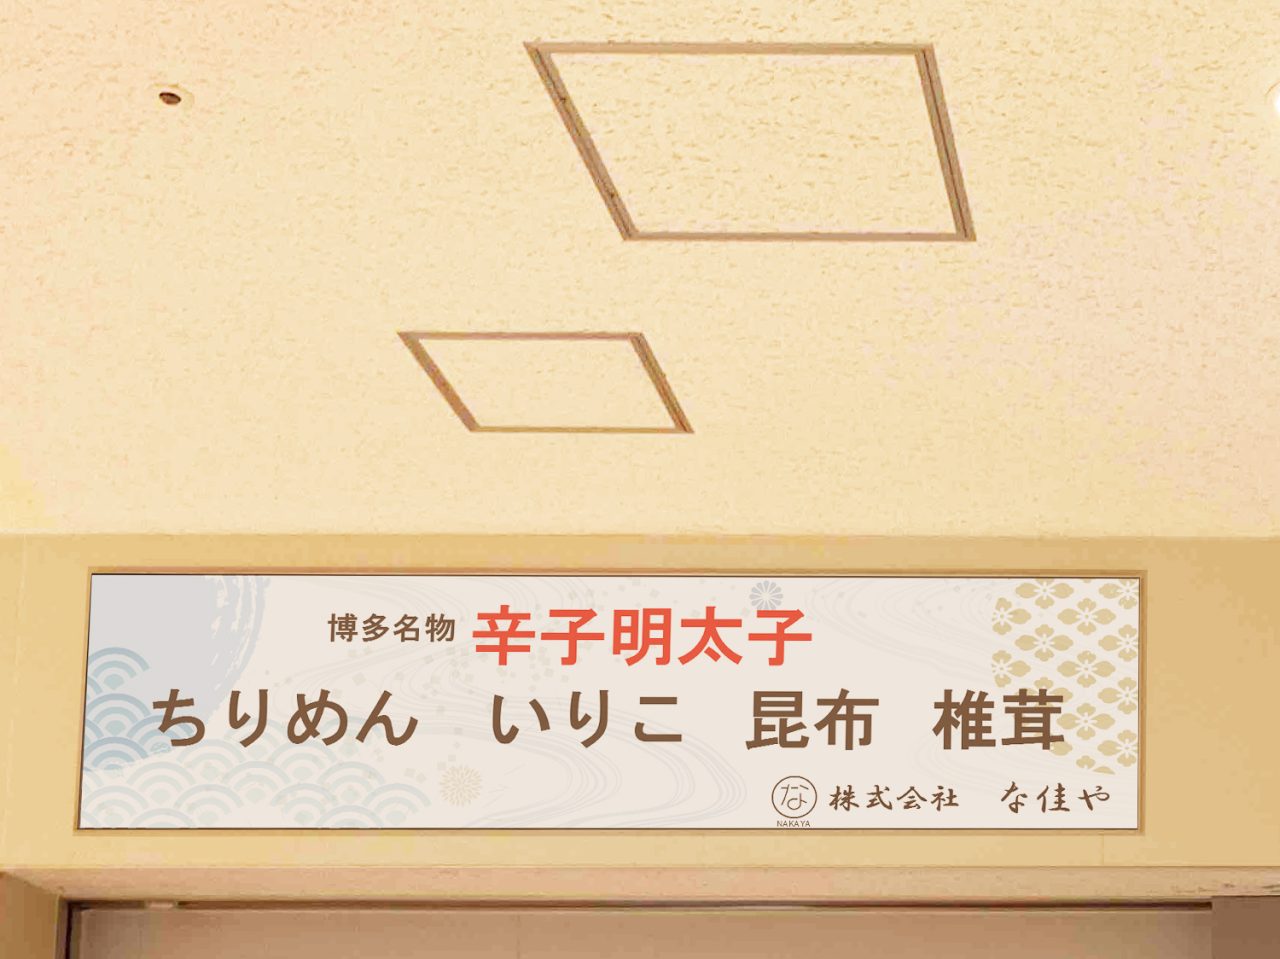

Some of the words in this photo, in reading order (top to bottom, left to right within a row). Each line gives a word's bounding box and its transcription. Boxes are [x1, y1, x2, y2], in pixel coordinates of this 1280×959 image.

[327, 613, 456, 642] 博多名物
[472, 605, 812, 665] 辛子明太子
[152, 688, 419, 747] ちりめん
[492, 690, 682, 747] いりこ
[746, 688, 879, 750] 昆布
[933, 688, 1065, 750] 椎茸
[829, 784, 959, 811] 株式会社
[1001, 781, 1110, 813] な佳や
[776, 819, 811, 828] NAKAYA
